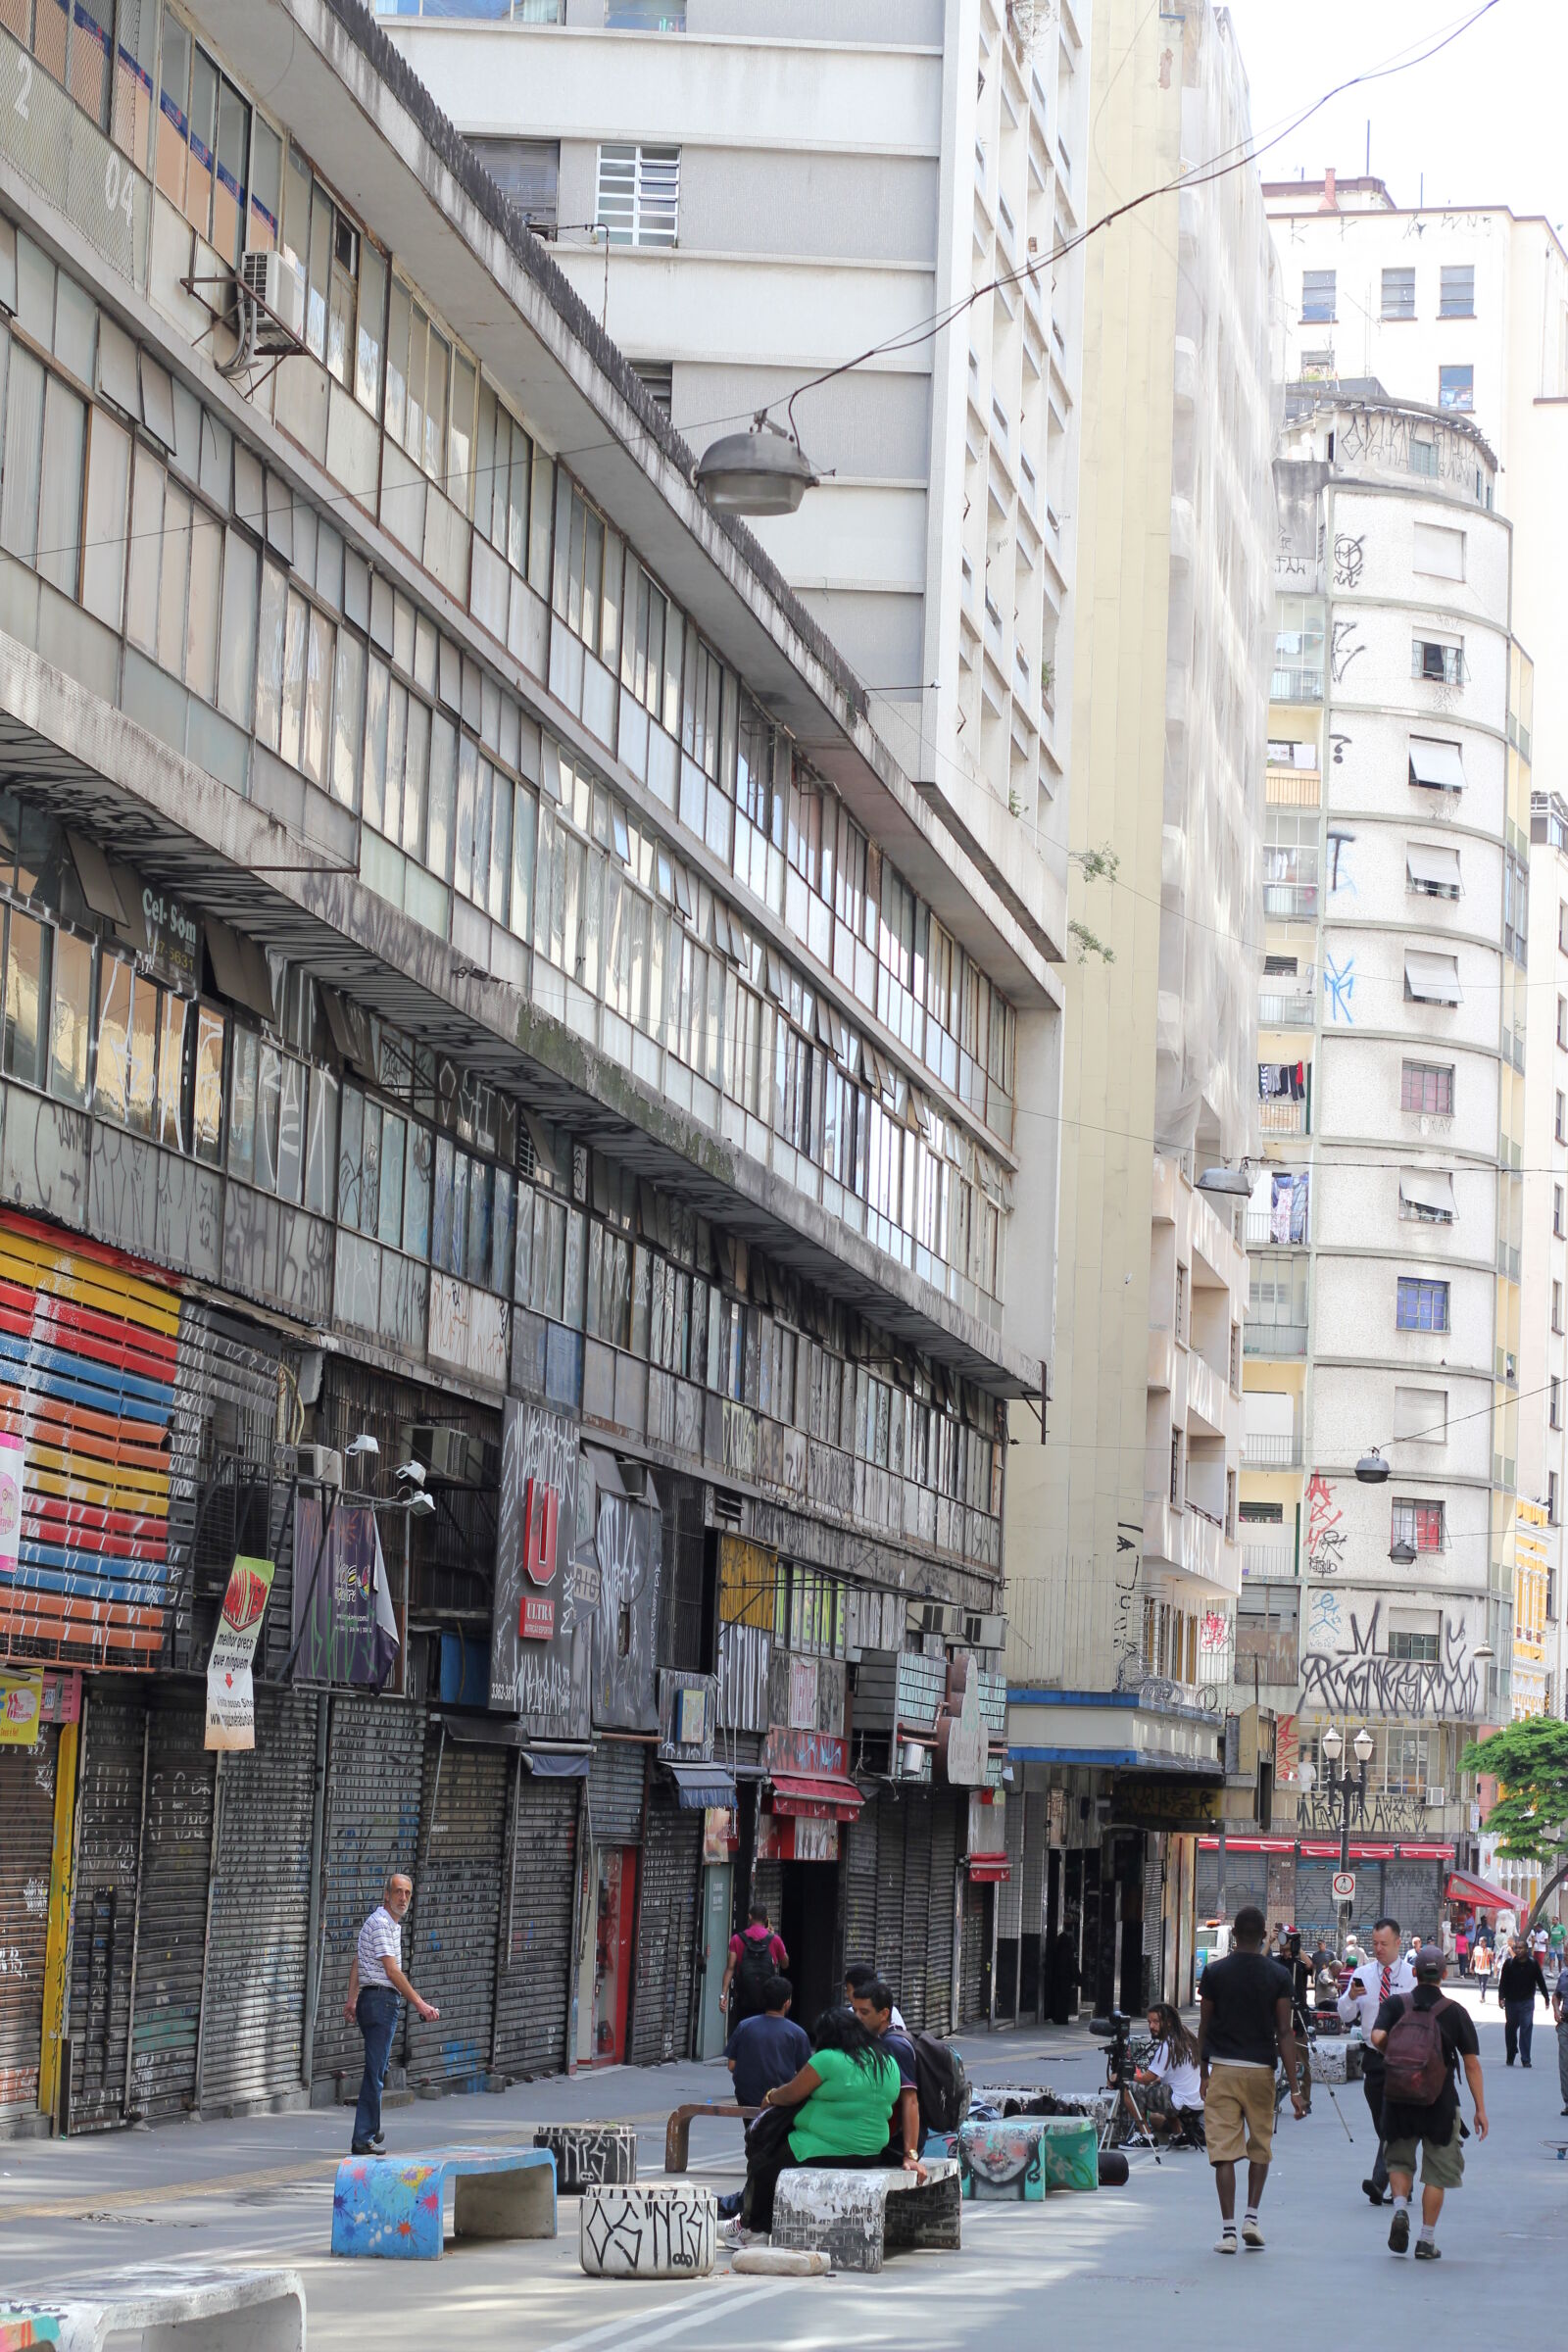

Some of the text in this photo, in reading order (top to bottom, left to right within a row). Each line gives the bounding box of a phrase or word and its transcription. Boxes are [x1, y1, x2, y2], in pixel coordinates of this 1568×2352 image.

[526, 1602, 552, 1621] ULTRA
[218, 1632, 237, 1647] melhor
[213, 1654, 225, 1669] que
